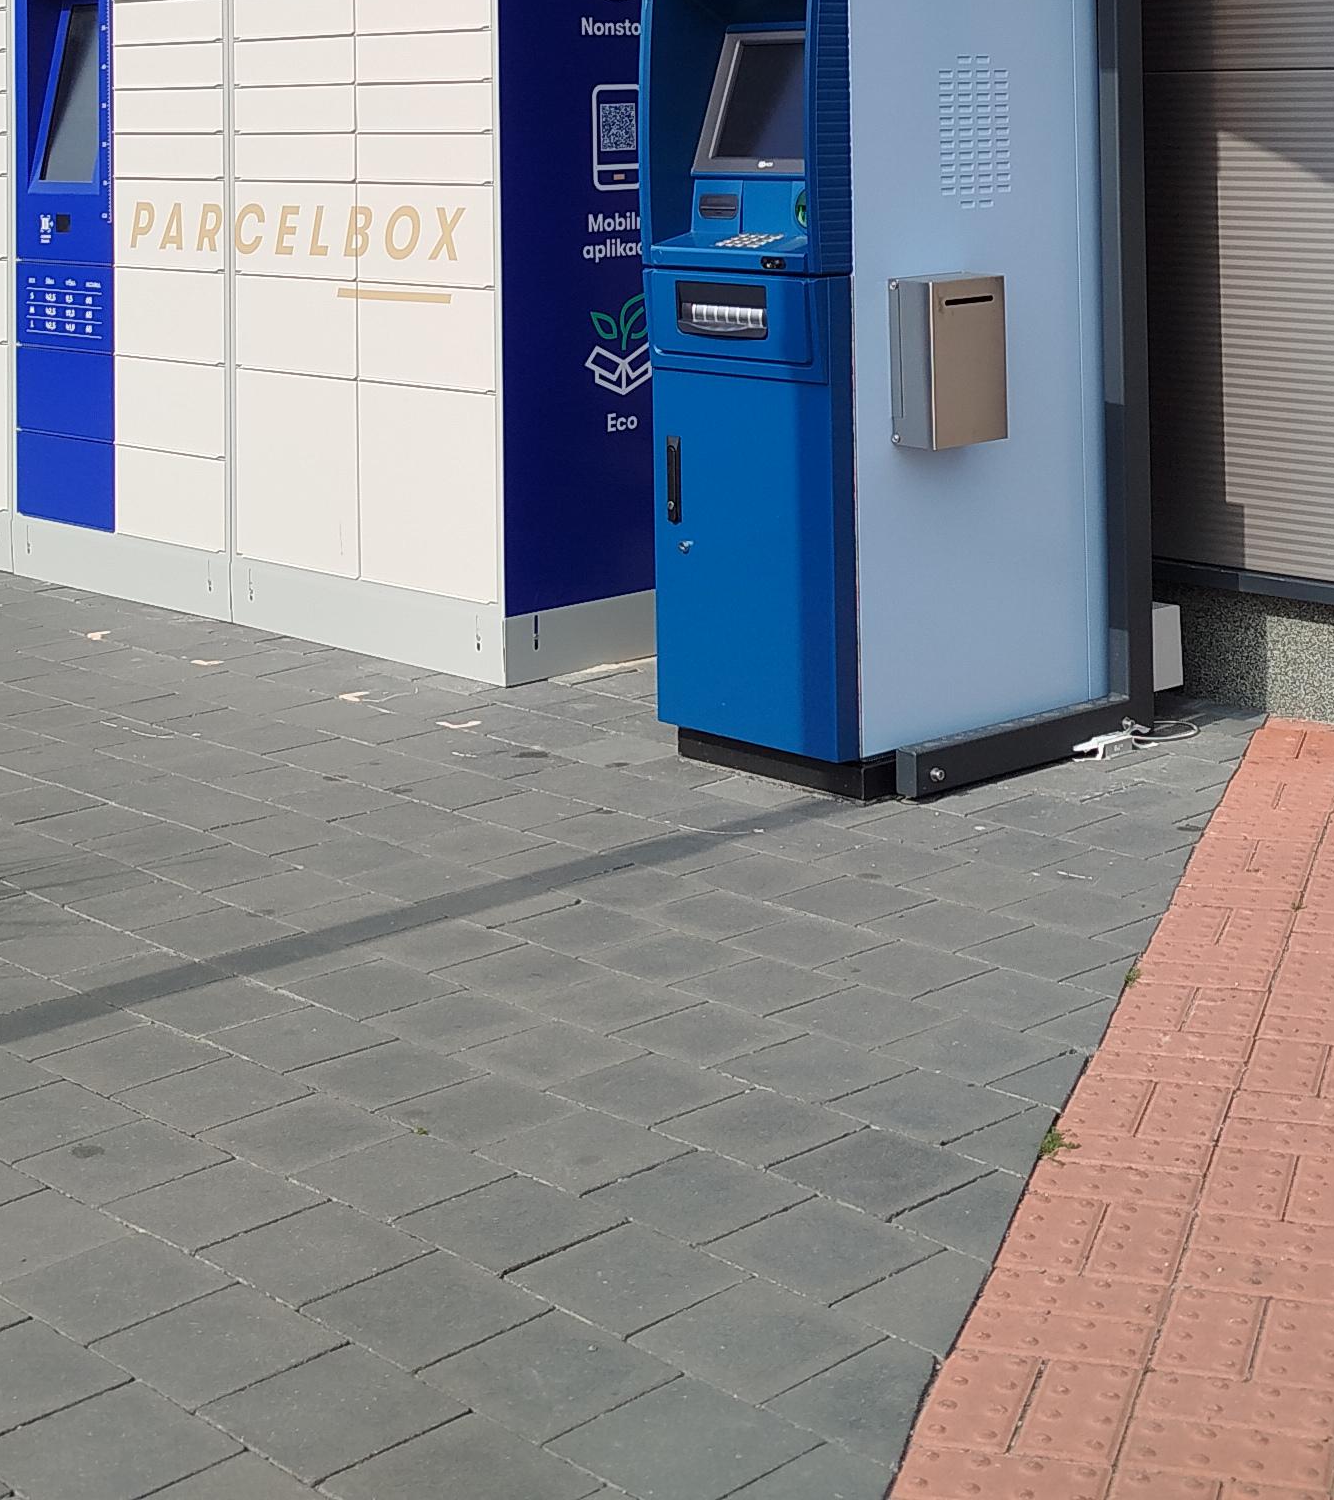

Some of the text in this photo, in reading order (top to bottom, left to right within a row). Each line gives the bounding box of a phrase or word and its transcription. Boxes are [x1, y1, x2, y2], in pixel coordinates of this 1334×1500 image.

[580, 16, 642, 37] Nonsto
[129, 201, 467, 262] PARCELBOX
[588, 211, 641, 232] Mobil
[606, 412, 639, 433] Eco
